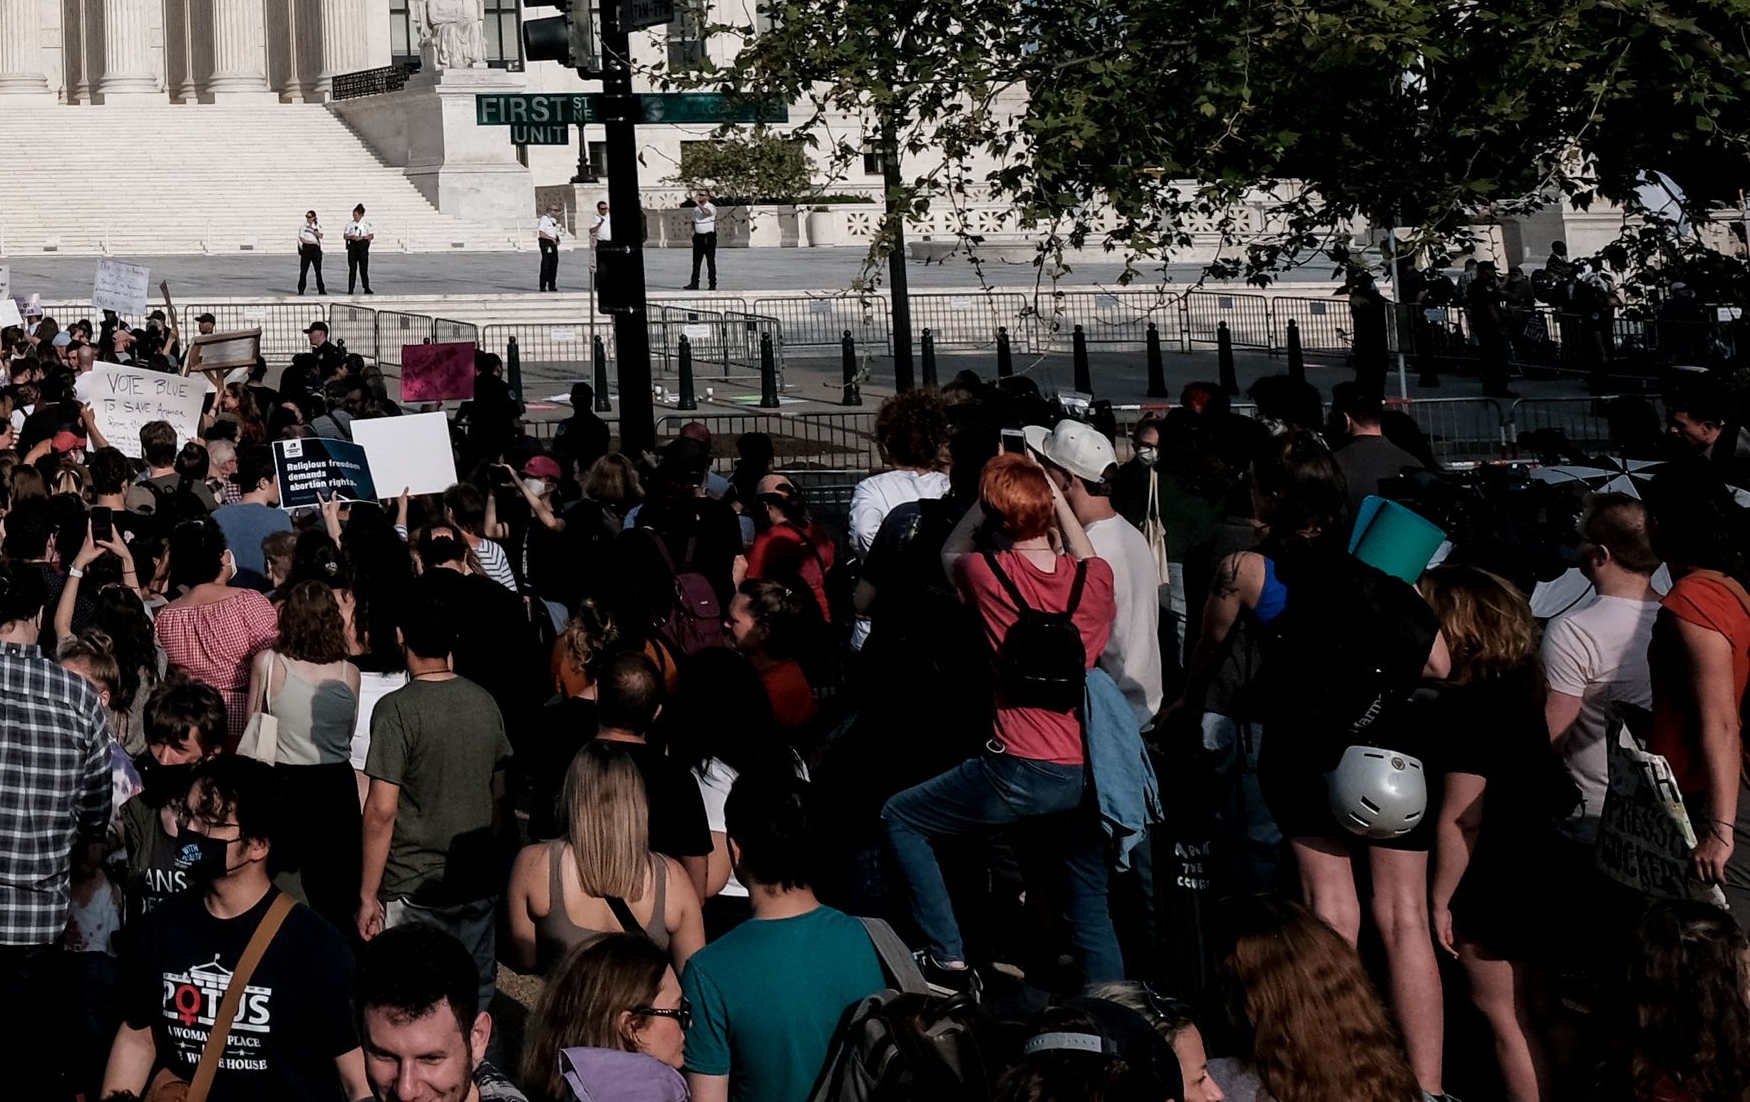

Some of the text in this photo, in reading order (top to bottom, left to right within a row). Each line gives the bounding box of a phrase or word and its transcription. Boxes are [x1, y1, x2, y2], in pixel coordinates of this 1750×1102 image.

[482, 97, 589, 122] FIRST ST
[573, 108, 593, 121] NE
[513, 125, 566, 143] UNIT
[106, 373, 188, 398] VOTE BLUE
[103, 398, 116, 413] TO
[123, 401, 151, 414] SAVE
[286, 459, 361, 472] Religious freedom
[288, 469, 327, 481] demands
[290, 480, 327, 491] abortion
[143, 867, 188, 893] ANS
[173, 1027, 261, 1048] WOMA PLACE
[226, 1058, 268, 1070] HOUSE
